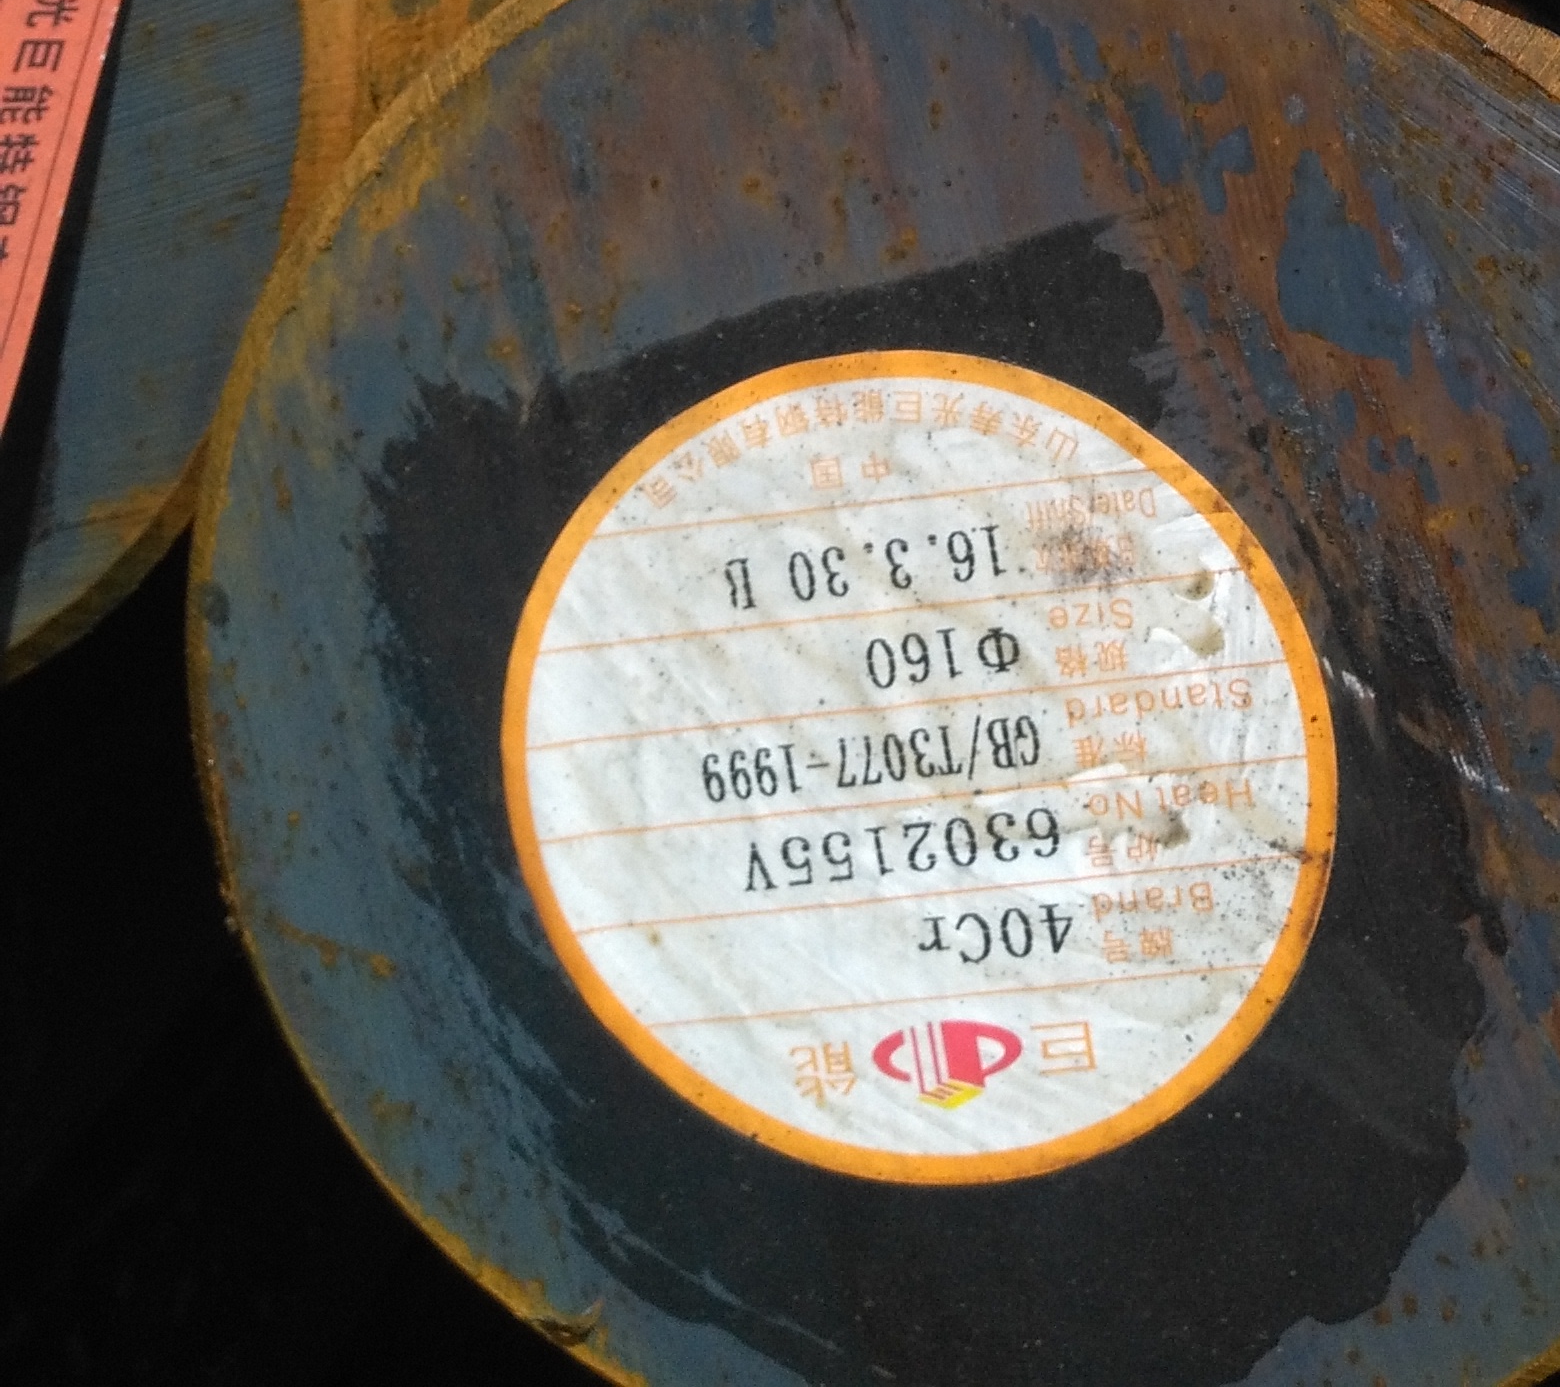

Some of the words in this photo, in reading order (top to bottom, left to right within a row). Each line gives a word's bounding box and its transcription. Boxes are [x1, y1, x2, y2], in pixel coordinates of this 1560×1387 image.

[642, 389, 1079, 507] 山东寿光巨能特钢有限公司
[809, 451, 892, 491] 中国
[1047, 598, 1134, 630] Size
[1055, 641, 1127, 677] 规格
[1065, 678, 1253, 728] Standard
[700, 715, 1040, 803] GB/T3077-1999
[1072, 732, 1147, 769] 标准
[1083, 791, 1145, 822] No
[1156, 779, 1254, 811] Heat
[744, 808, 1060, 891] 6302155V
[1085, 833, 1159, 867] 炉号
[1091, 882, 1214, 922] Brand
[918, 904, 1073, 964] 40Cr
[1101, 928, 1174, 963] 牌号
